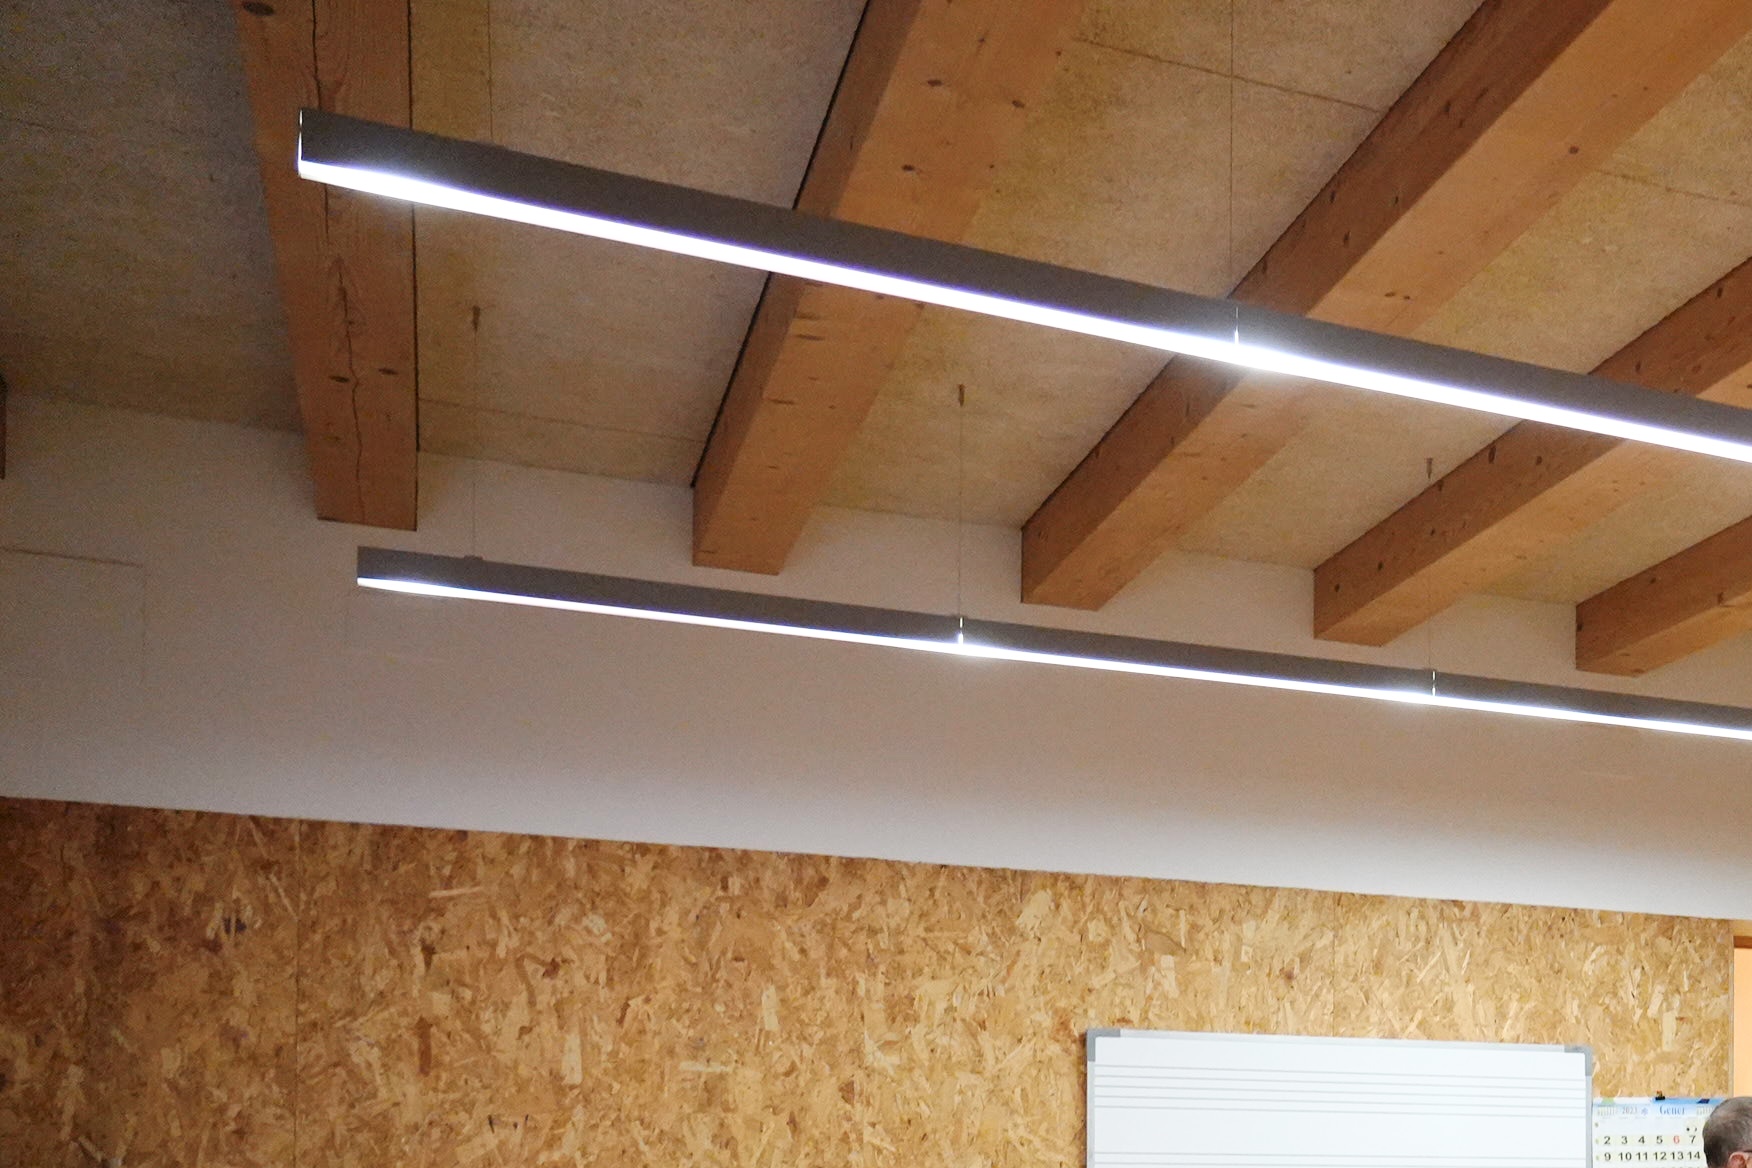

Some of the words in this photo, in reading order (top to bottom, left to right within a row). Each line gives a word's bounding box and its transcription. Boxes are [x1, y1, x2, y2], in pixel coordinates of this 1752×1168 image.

[1659, 1105, 1685, 1115] Gener
[1603, 1135, 1611, 1145] 2
[1621, 1135, 1628, 1145] 3
[1638, 1135, 1645, 1144] 4
[1656, 1135, 1663, 1144] 5
[1673, 1135, 1680, 1144] 6
[1689, 1135, 1696, 1144] 7
[1604, 1152, 1611, 1161] 9
[1619, 1152, 1632, 1161] 10
[1636, 1152, 1648, 1160] 11
[1653, 1152, 1667, 1160] 12
[1670, 1151, 1684, 1160] 13
[1687, 1151, 1701, 1160] 14
